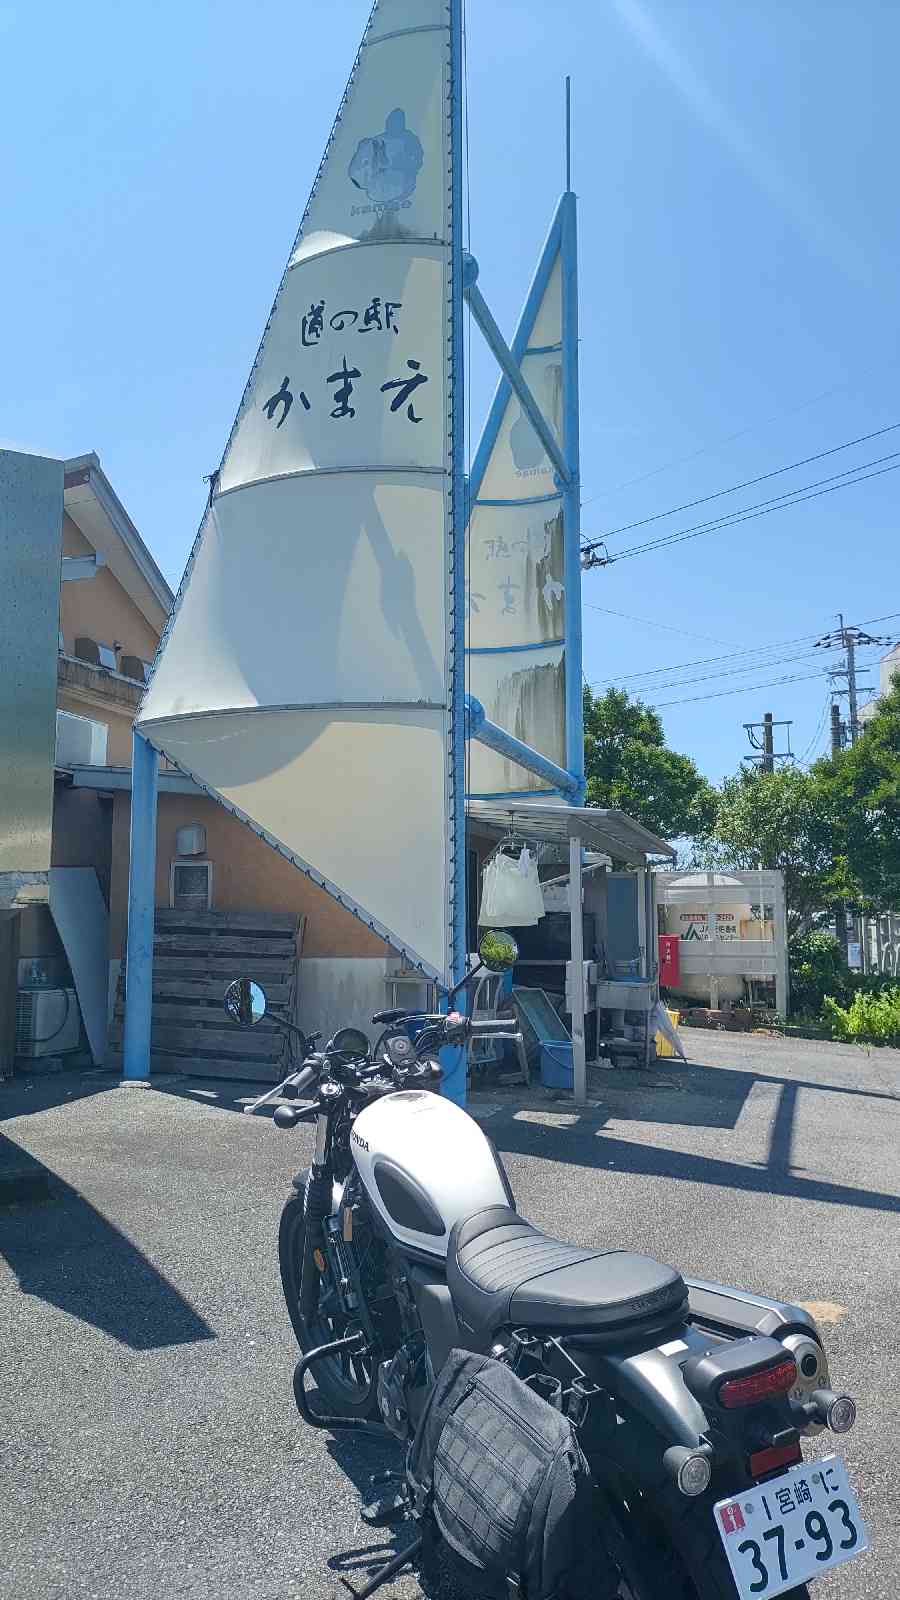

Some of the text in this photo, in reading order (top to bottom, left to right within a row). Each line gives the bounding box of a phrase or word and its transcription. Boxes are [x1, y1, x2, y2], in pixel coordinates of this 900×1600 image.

[301, 297, 402, 346] 道の駅
[262, 355, 428, 429] かまえ
[819, 1468, 839, 1494] に
[737, 1499, 857, 1593] 37-93
